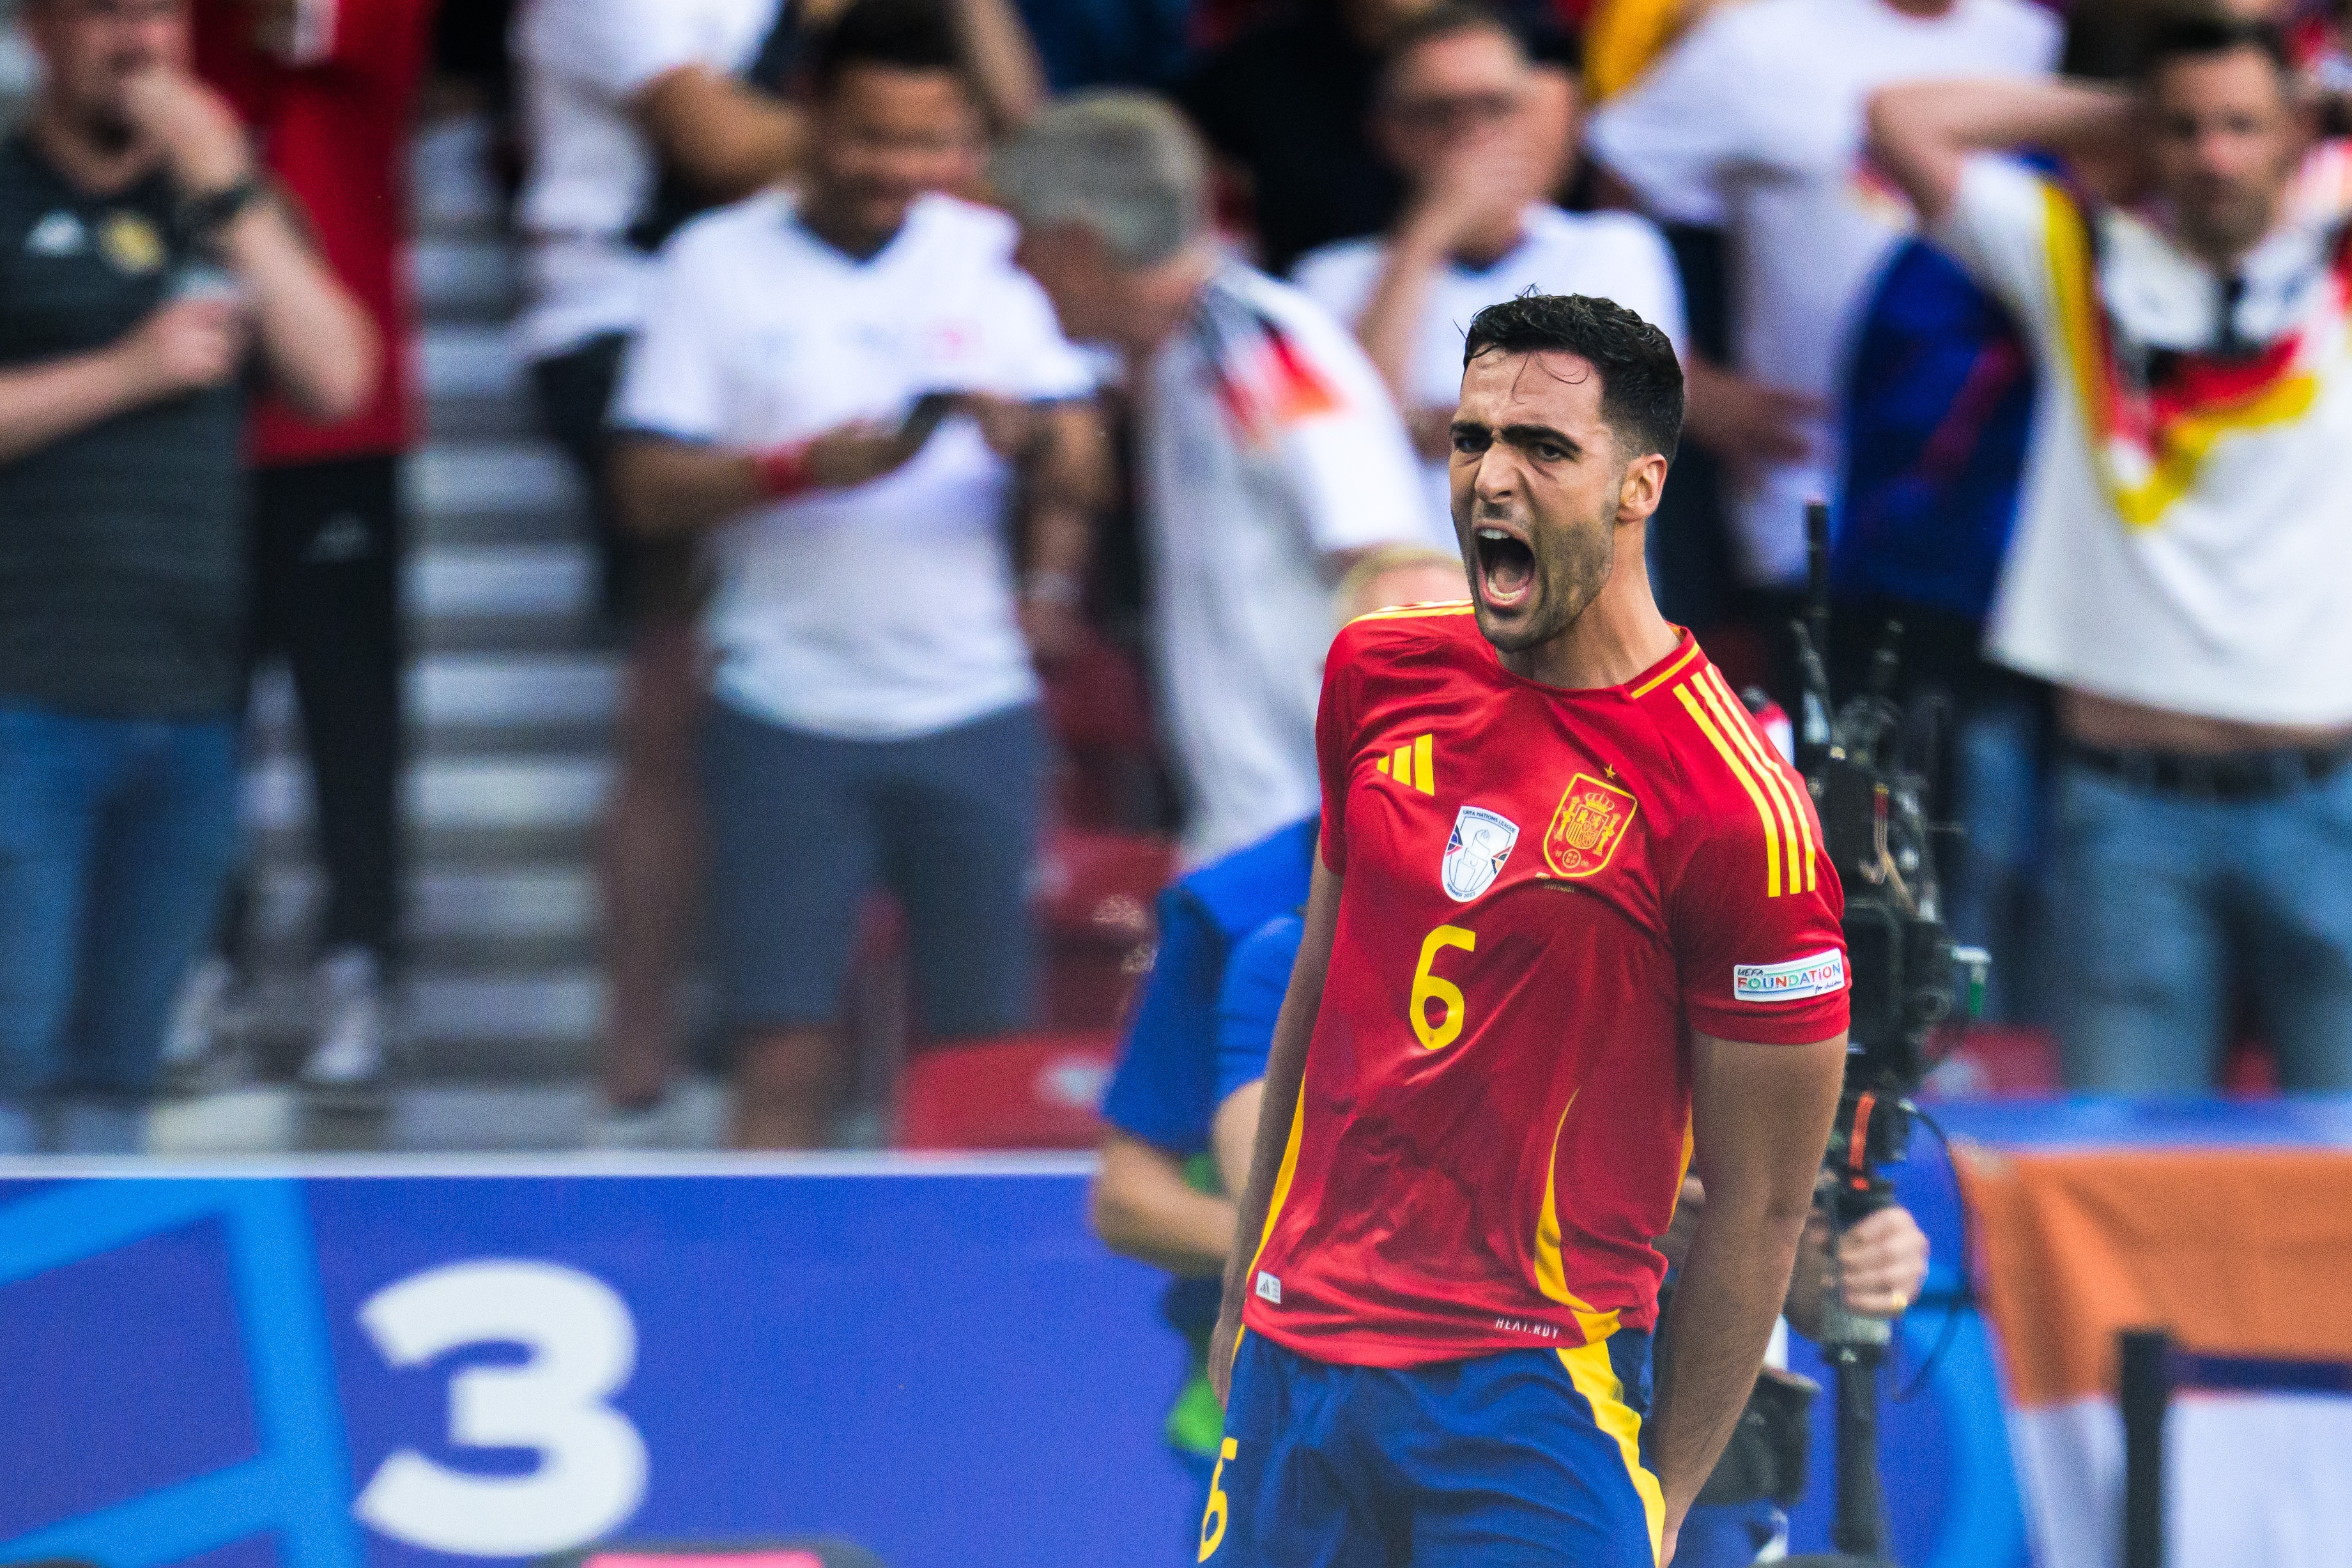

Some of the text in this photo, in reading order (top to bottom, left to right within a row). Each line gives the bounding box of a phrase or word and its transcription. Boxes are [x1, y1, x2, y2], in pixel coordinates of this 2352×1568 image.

[1477, 812, 1498, 823] NATIONS
[1498, 819, 1516, 834] LEAGUE
[1410, 924, 1476, 1050] 6
[1737, 968, 1764, 976] UEFA
[1824, 980, 1842, 990] children
[354, 1259, 649, 1556] 3
[1197, 1436, 1238, 1563] 6
